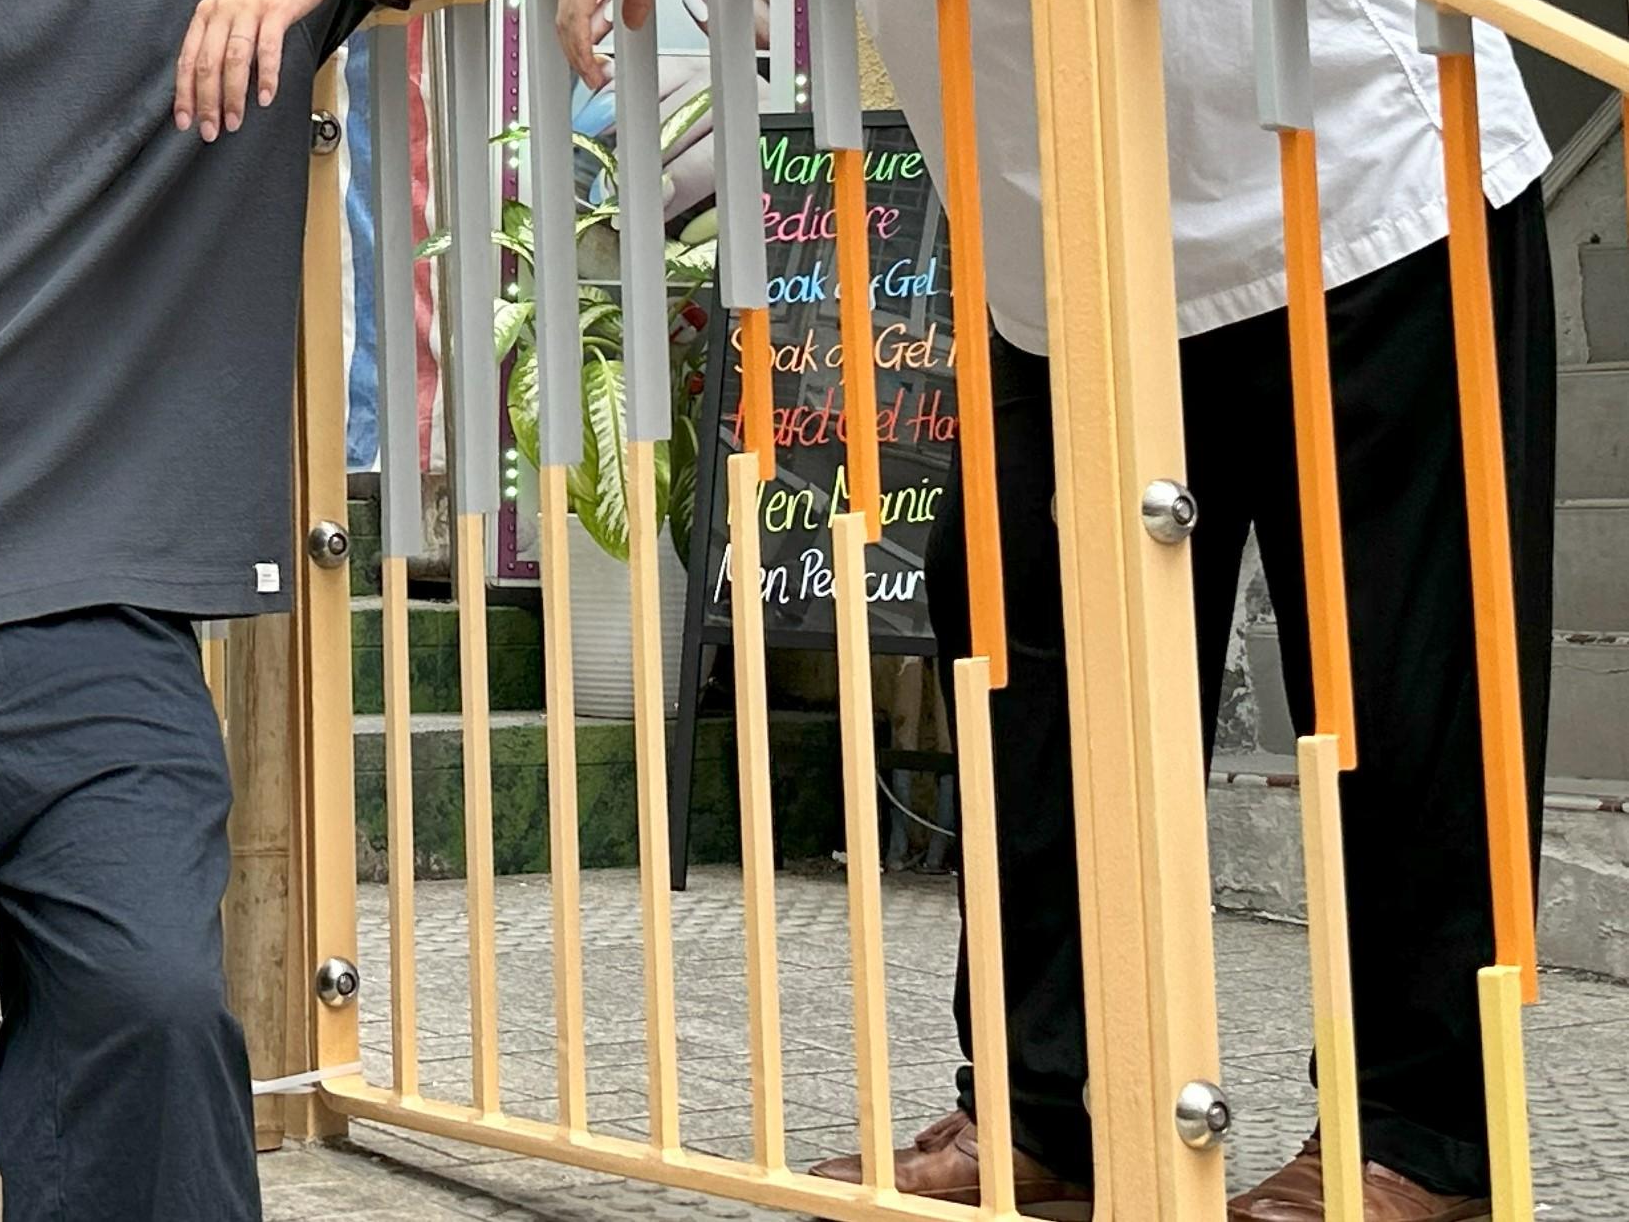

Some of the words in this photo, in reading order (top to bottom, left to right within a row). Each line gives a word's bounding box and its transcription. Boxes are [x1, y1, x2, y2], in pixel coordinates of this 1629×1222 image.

[767, 261, 828, 303] oak
[885, 257, 939, 297] Gel
[875, 322, 938, 371] Gel
